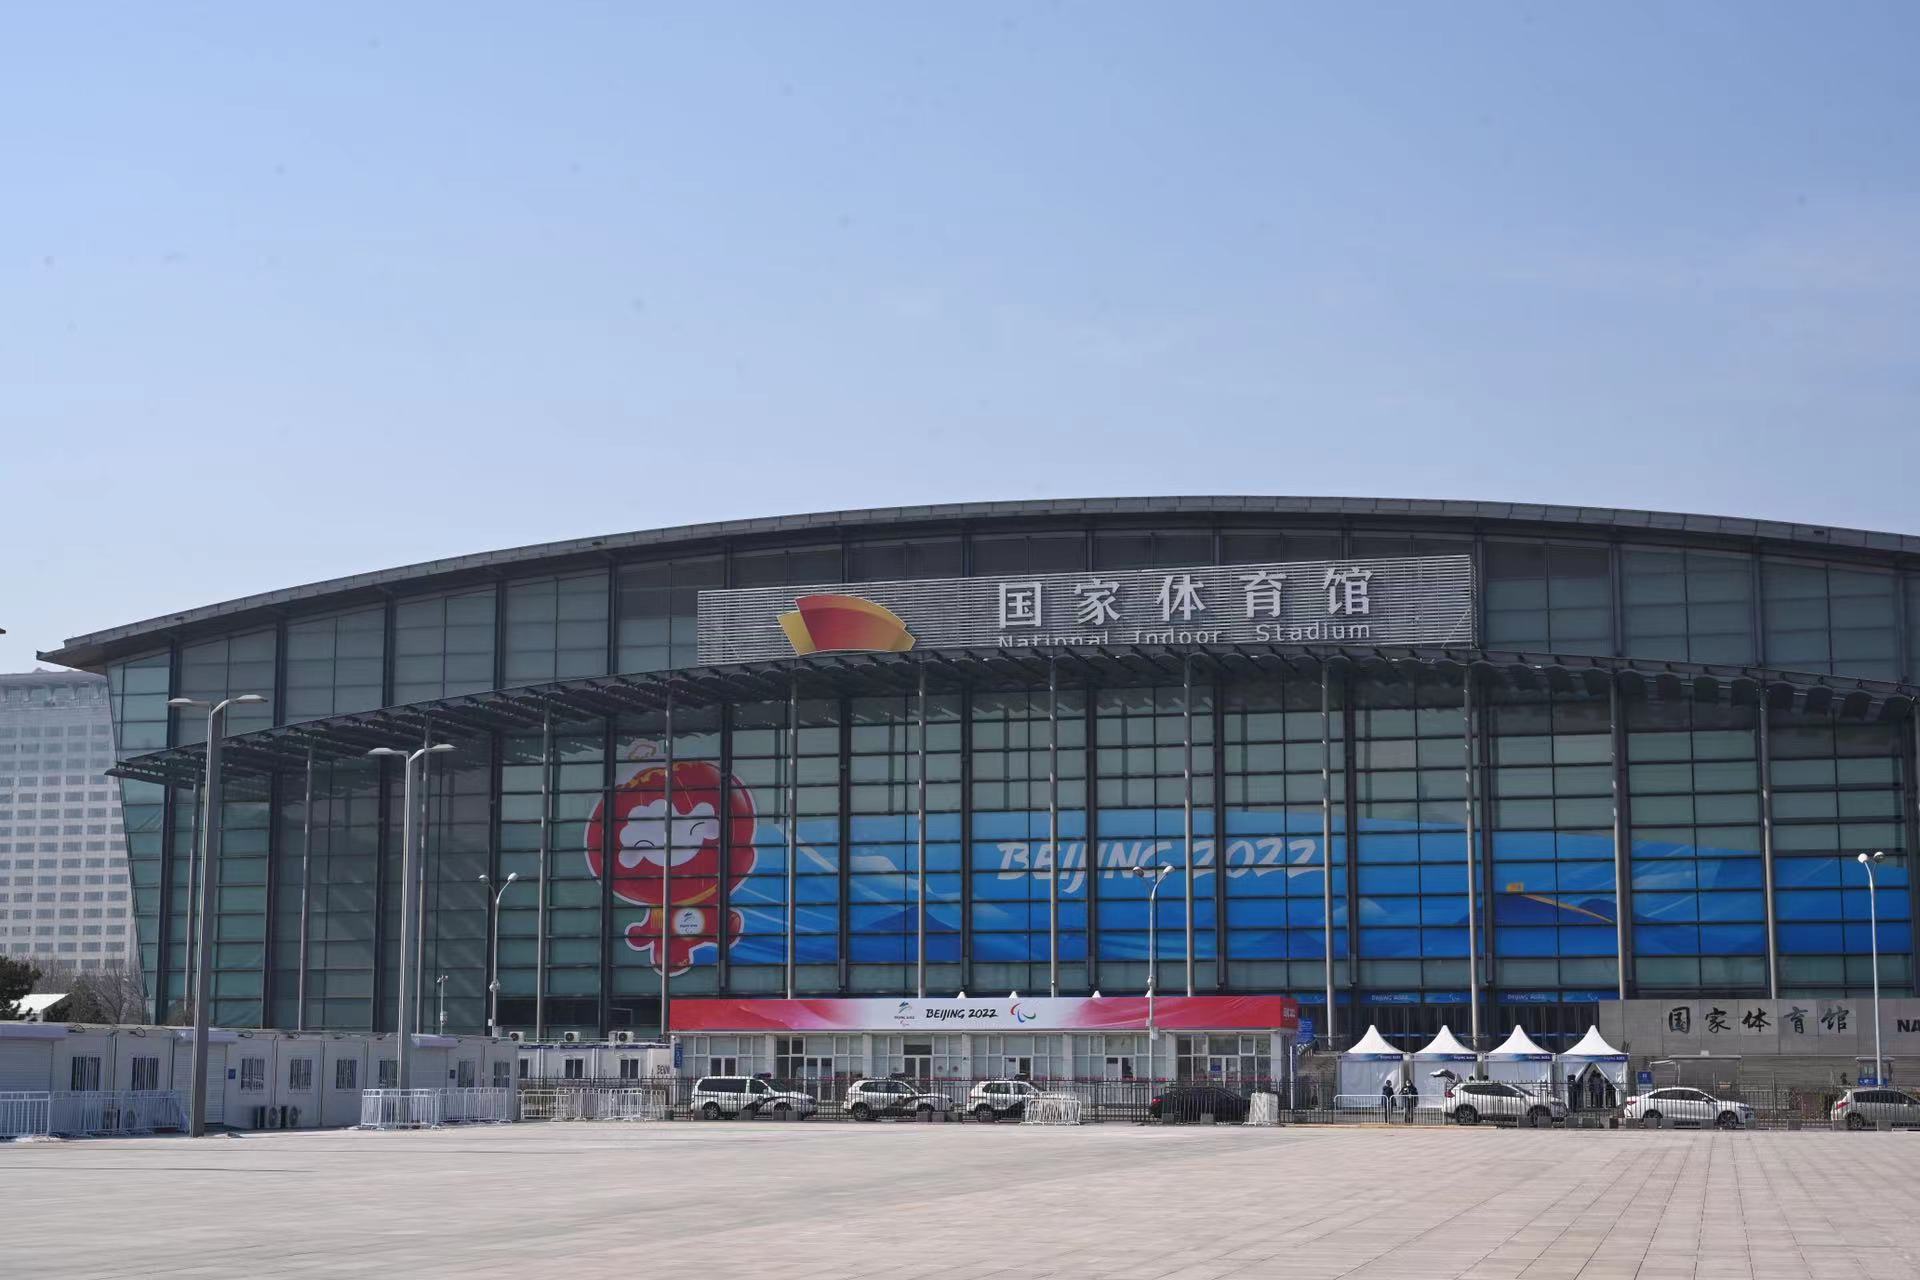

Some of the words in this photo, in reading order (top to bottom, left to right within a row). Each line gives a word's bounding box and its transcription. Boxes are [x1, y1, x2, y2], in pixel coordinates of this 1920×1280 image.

[1000, 566, 1373, 628] 国家体育馆
[999, 631, 1110, 648] National
[1136, 628, 1223, 645] Indoor
[1256, 621, 1370, 642] Stadium
[997, 841, 1173, 893] BEIJING
[1193, 837, 1325, 879] 2022
[926, 1008, 965, 1021] BEIJING
[968, 1008, 998, 1019] 2022
[1669, 1006, 1850, 1034] 国家体育馆
